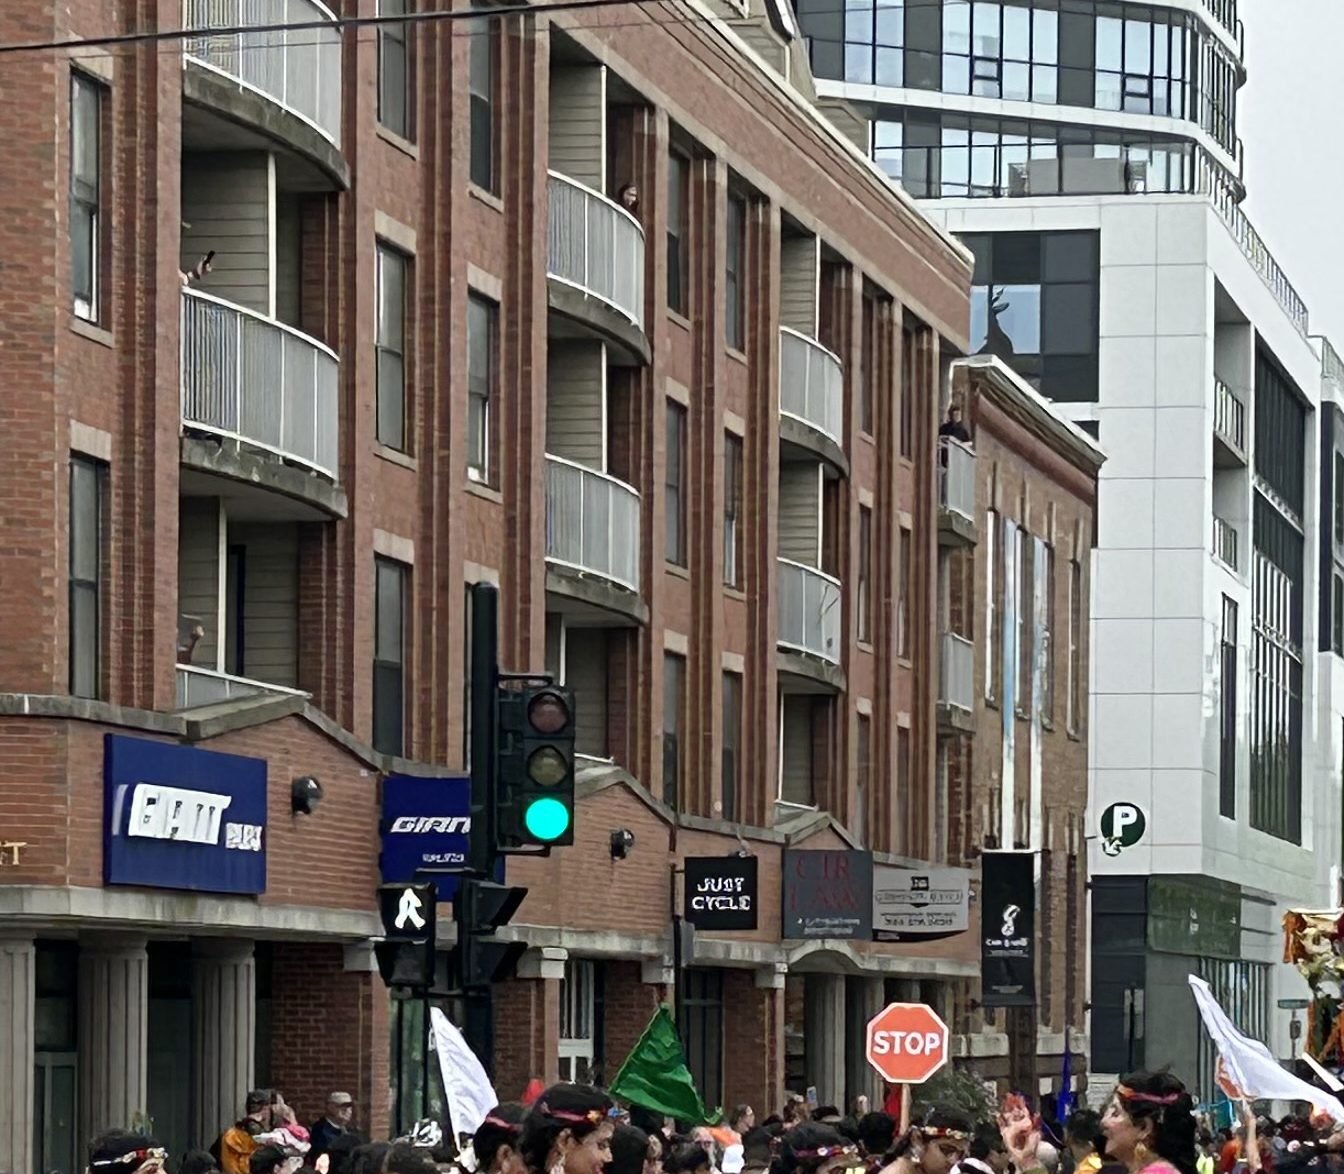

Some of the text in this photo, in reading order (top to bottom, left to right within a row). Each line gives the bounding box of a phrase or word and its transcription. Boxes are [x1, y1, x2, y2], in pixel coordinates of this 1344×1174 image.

[391, 817, 471, 833] GIAN
[1113, 805, 1138, 838] P
[873, 1030, 941, 1056] STOP
